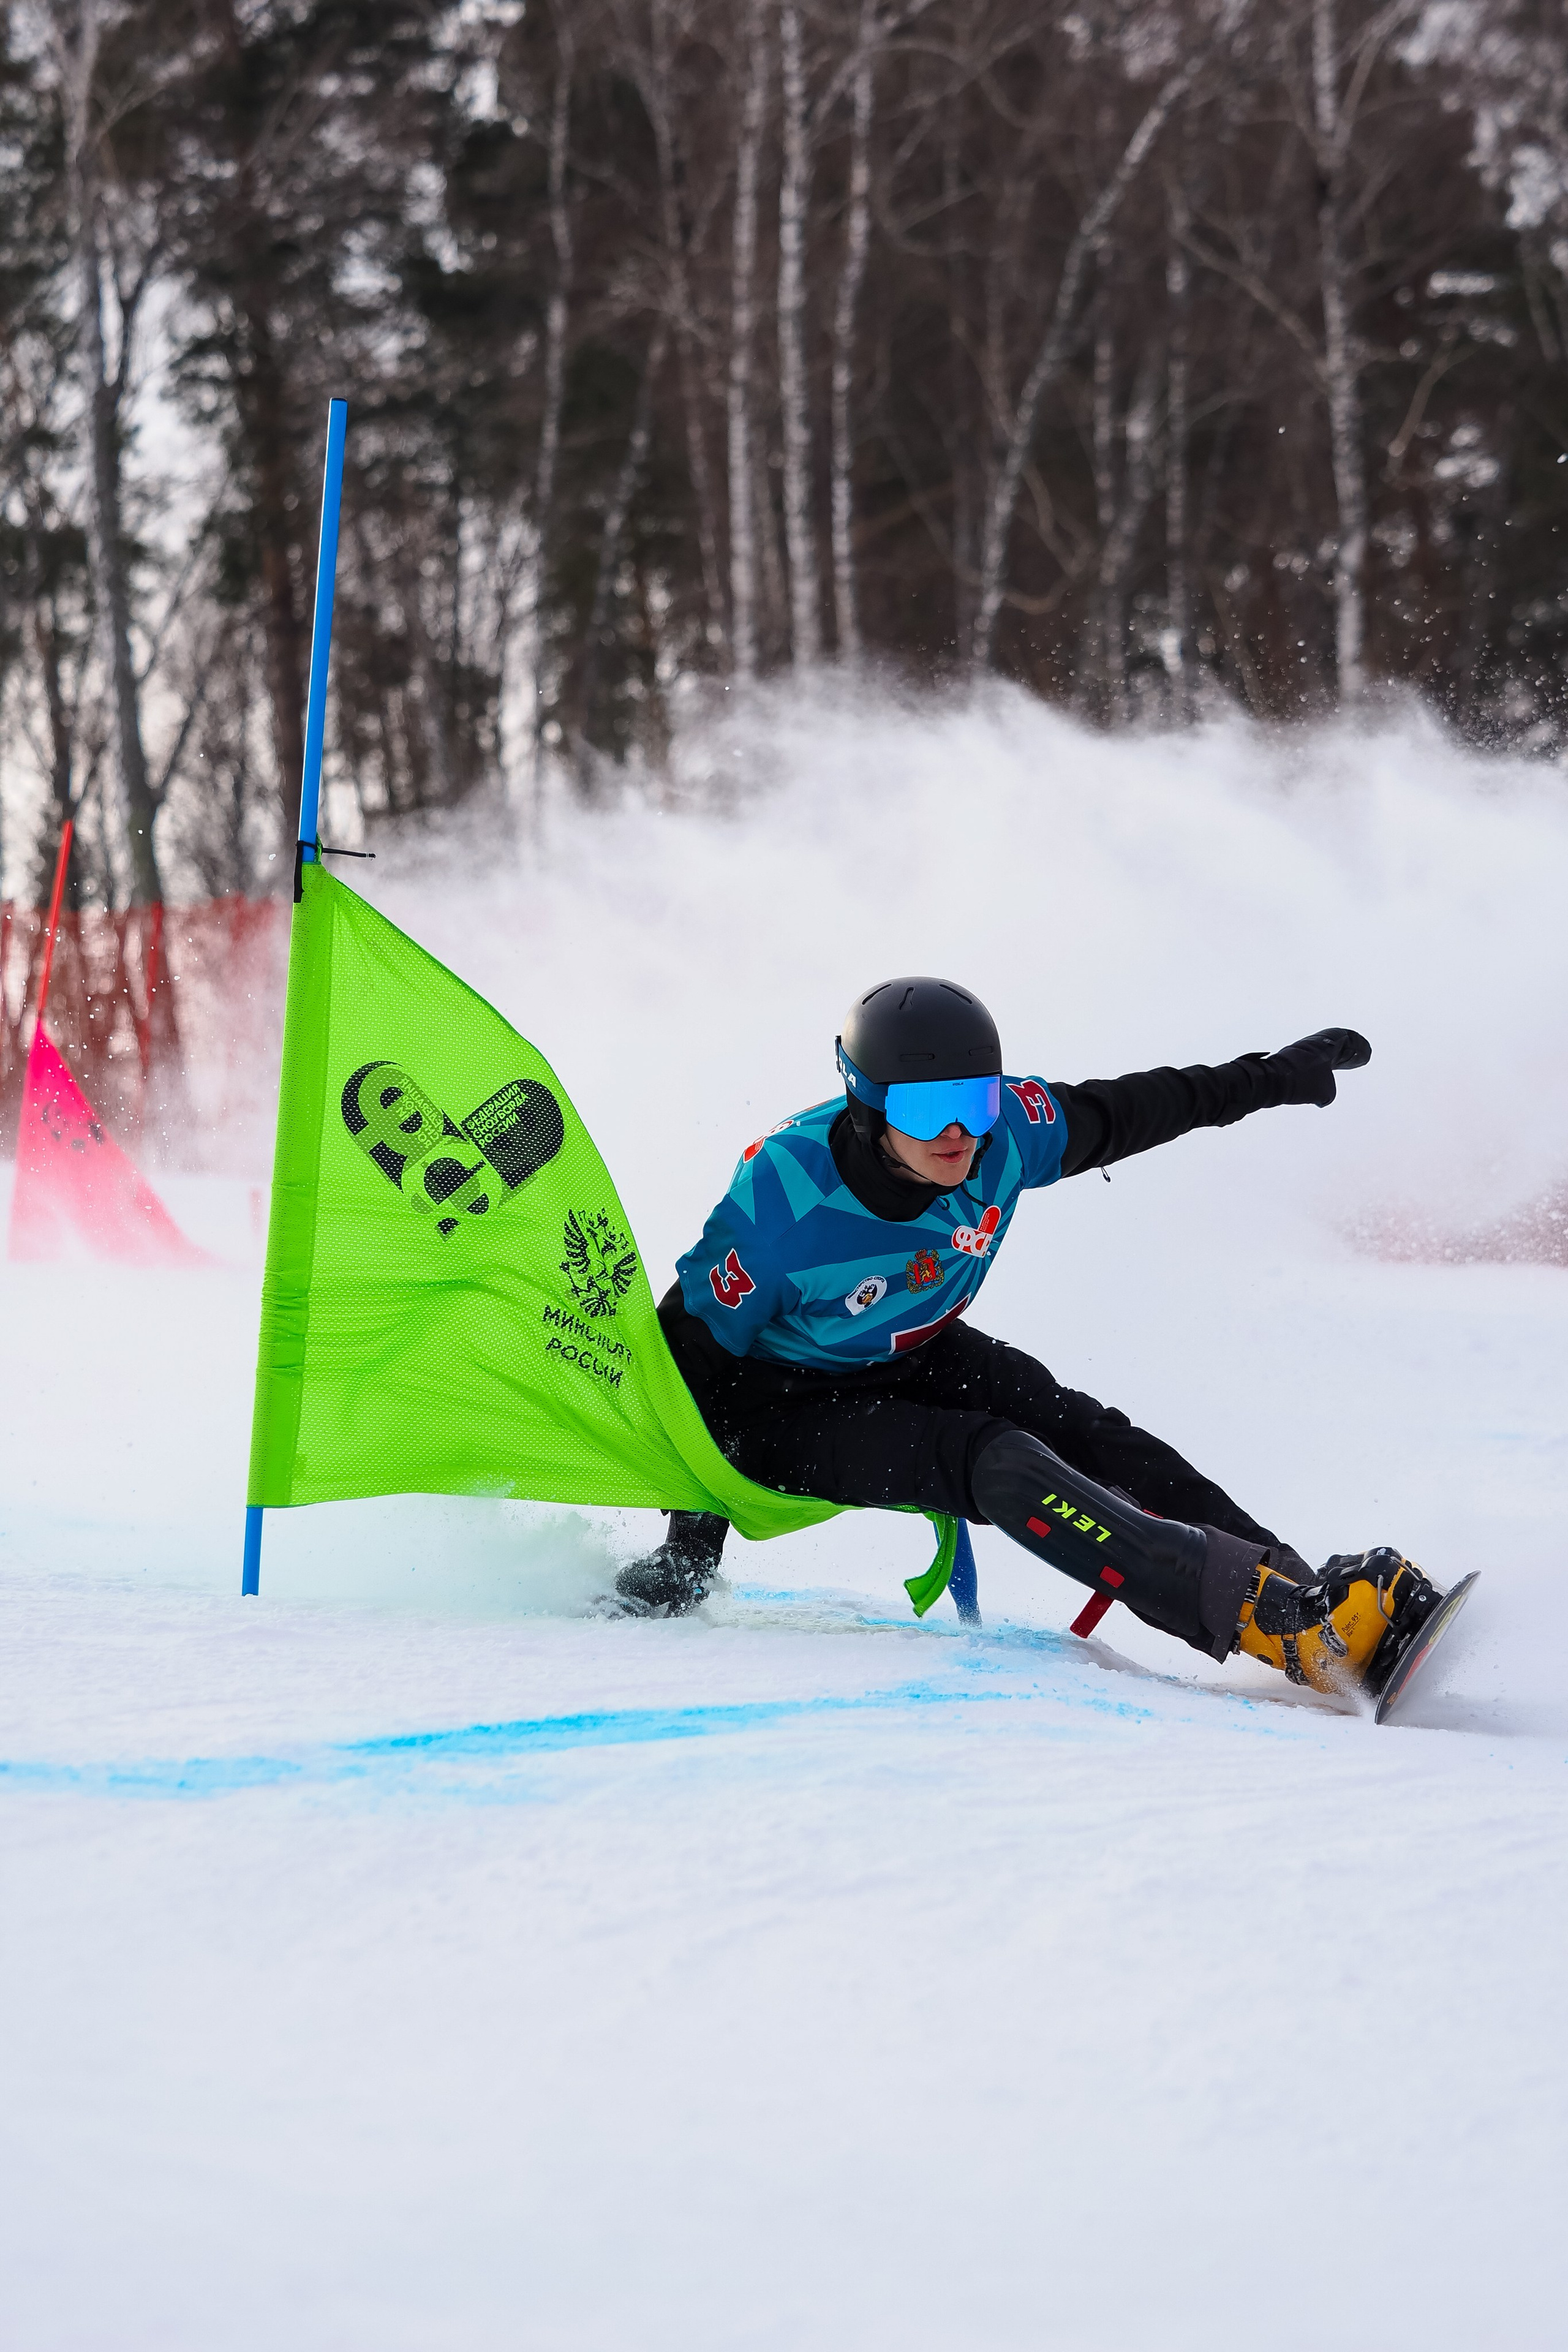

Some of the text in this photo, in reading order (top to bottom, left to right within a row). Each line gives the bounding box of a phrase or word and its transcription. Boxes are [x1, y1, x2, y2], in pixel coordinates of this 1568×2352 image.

[839, 1056, 856, 1088] OLA
[467, 1084, 521, 1129] ФЕДЕРАЦИЯ
[473, 1092, 530, 1138] СНОУБОРДА
[478, 1112, 519, 1148] РОССИИ
[1042, 1493, 1112, 1542] LEKI
